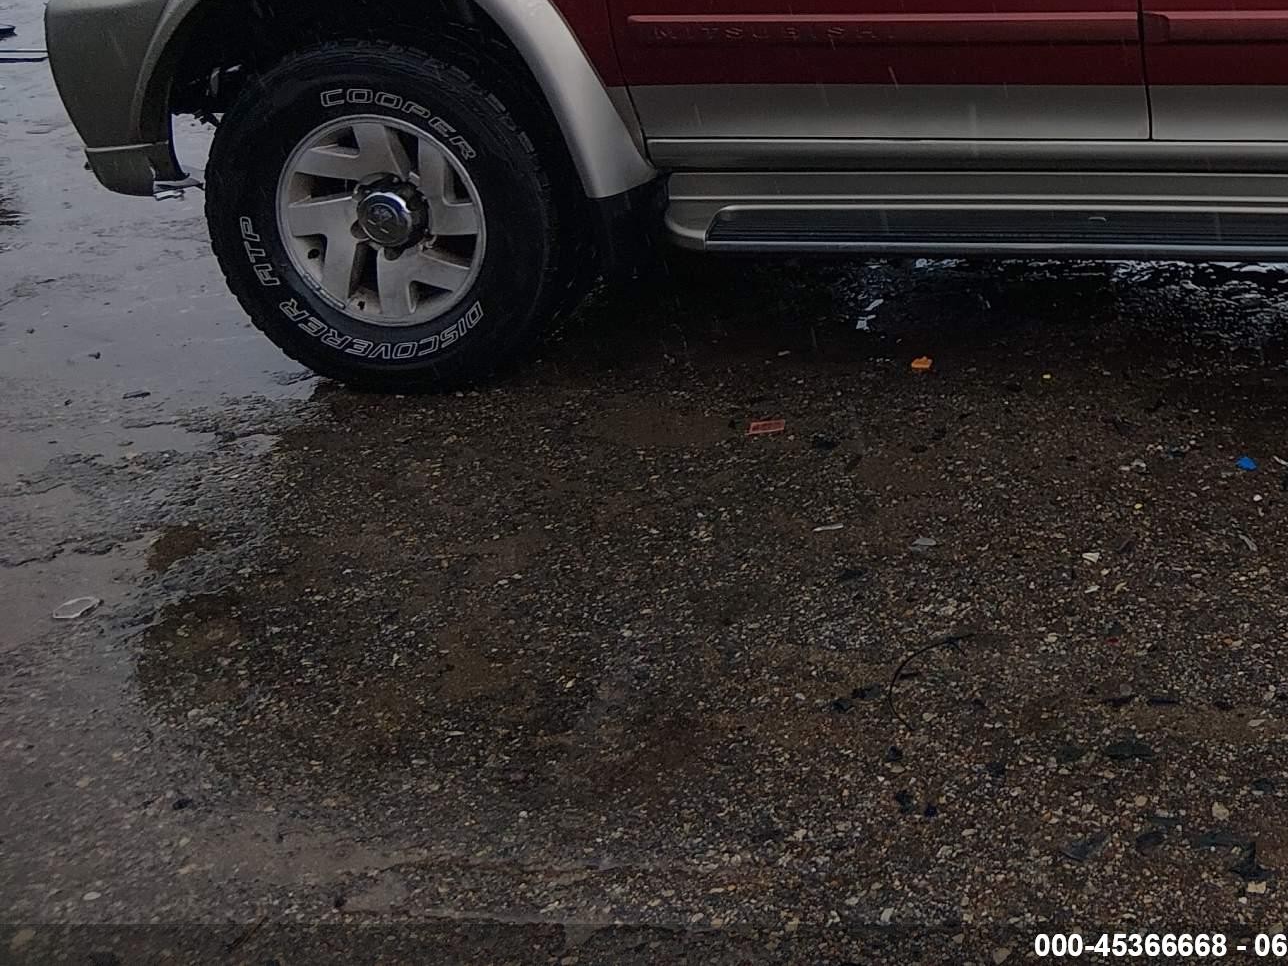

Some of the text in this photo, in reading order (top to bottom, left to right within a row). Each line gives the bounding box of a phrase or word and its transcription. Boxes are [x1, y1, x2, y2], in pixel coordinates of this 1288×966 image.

[320, 87, 477, 162] COOPER
[239, 215, 485, 360] DISCOVERER ATP
